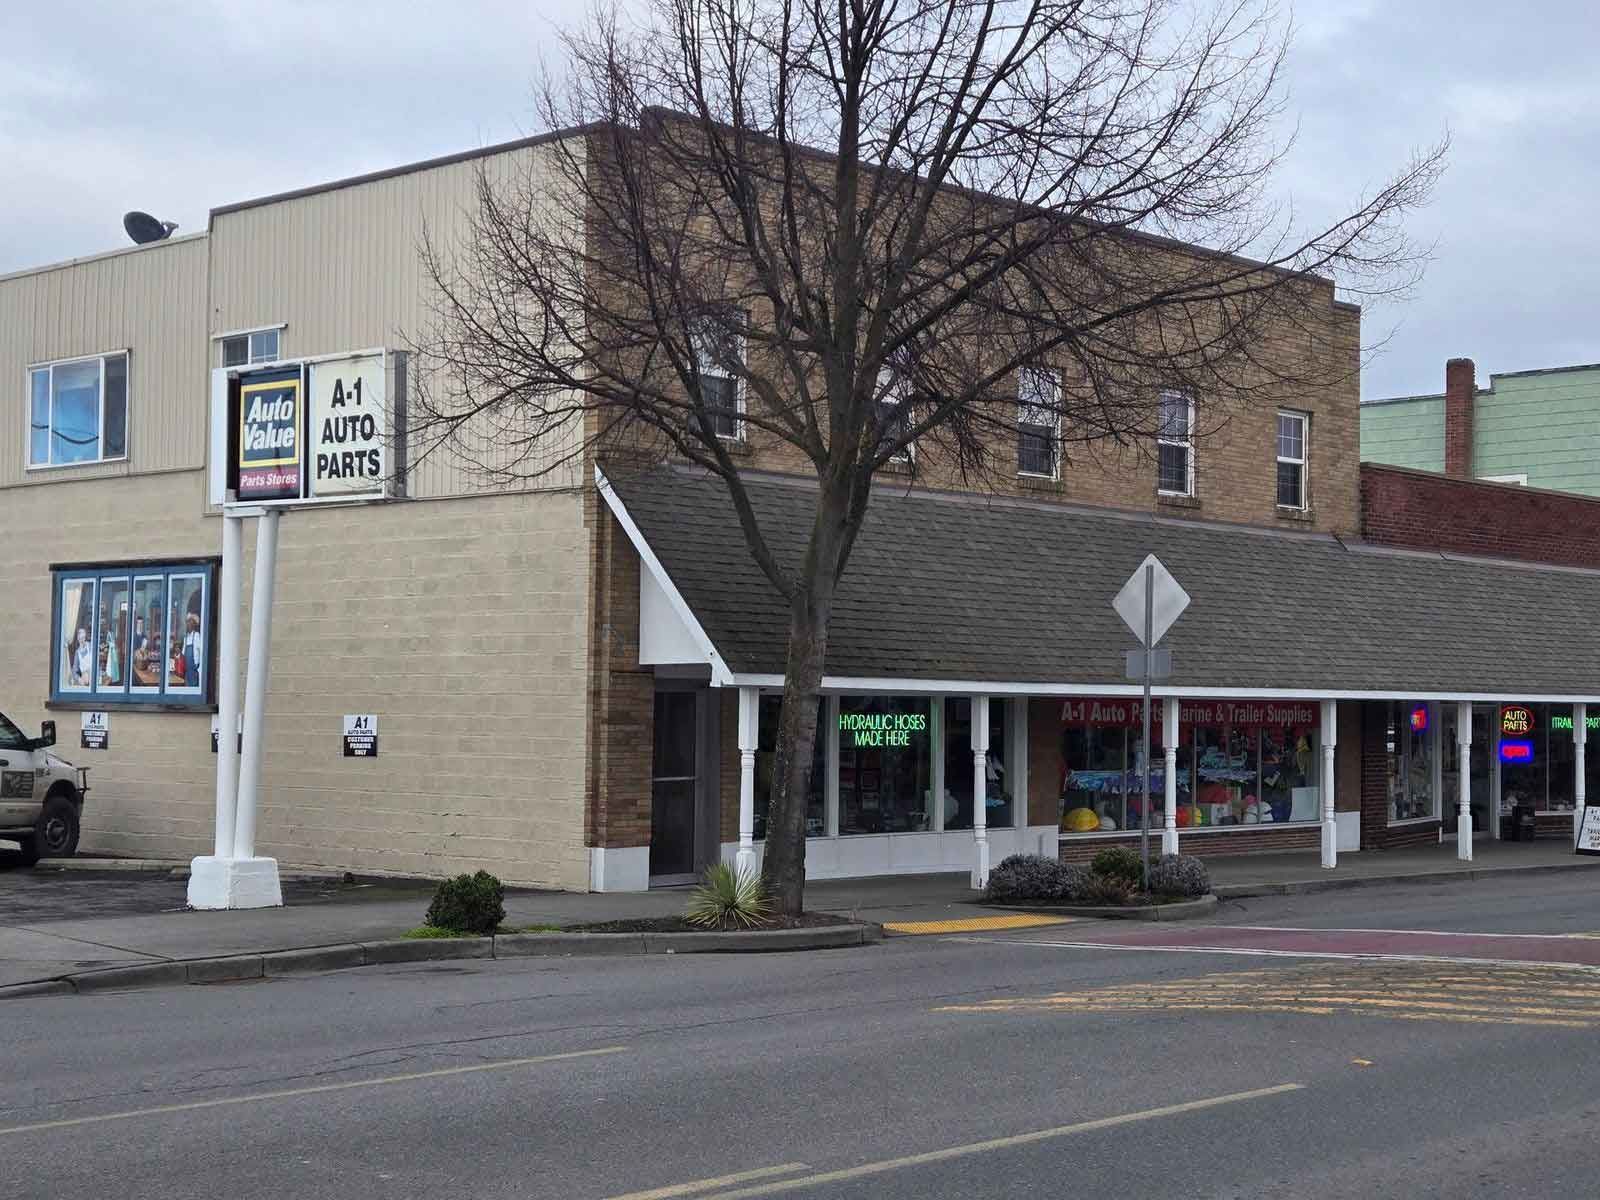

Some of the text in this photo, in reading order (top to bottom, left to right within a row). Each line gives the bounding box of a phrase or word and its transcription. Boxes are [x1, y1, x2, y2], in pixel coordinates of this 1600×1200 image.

[331, 376, 363, 408] A-1
[247, 395, 294, 423] Auto
[244, 423, 296, 450] Value
[321, 413, 376, 444] AUTO
[317, 448, 381, 479] PARTS
[240, 472, 297, 487] Parts Stores
[354, 716, 369, 729] A1
[839, 714, 926, 730] HYDRAULIC HOSES
[1061, 701, 1313, 727] A-1 Auto Pats arine & Trailer Supplies
[1504, 710, 1527, 720] AUTO
[1503, 721, 1528, 731] PARTS
[855, 730, 911, 746] MADE HERE
